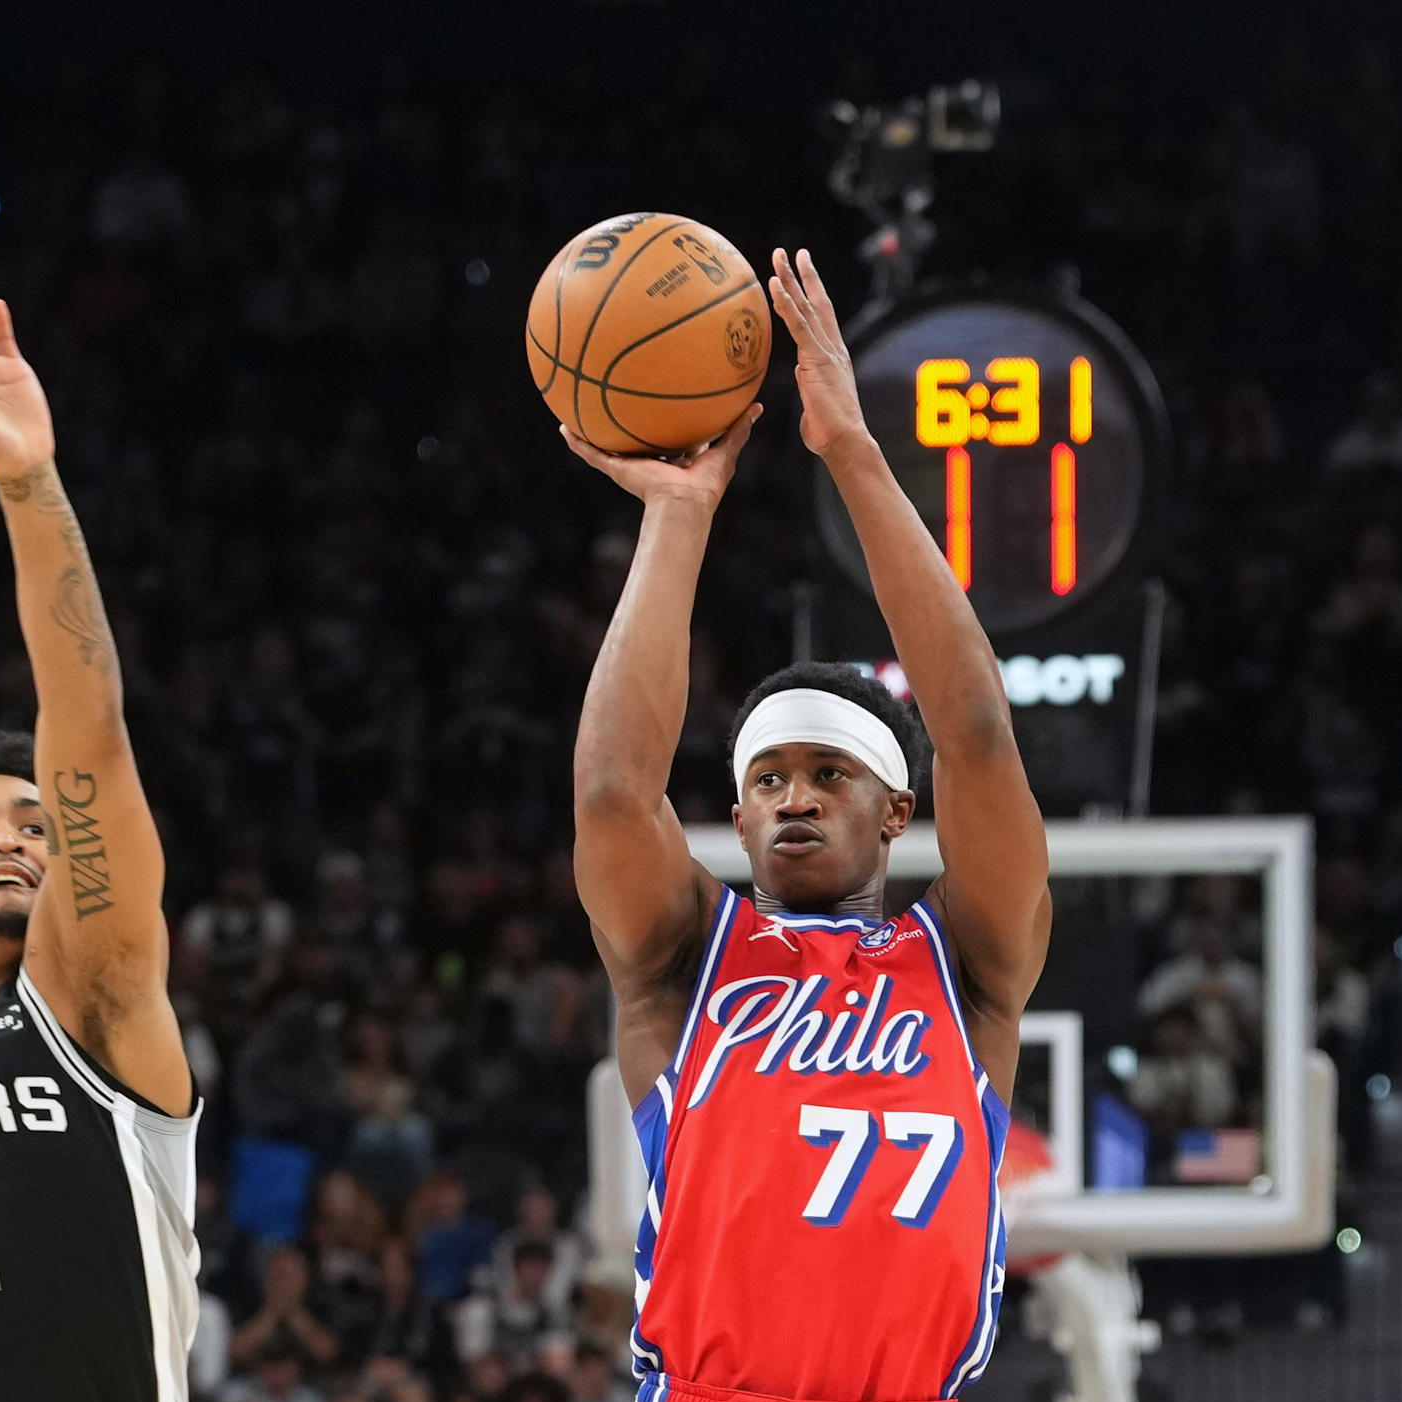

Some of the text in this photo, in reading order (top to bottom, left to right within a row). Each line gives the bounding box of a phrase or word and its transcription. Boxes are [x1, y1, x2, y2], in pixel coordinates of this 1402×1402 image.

[916, 356, 1093, 447] 6:31
[946, 442, 1076, 596] 11
[687, 974, 932, 1110] Phila
[799, 1104, 964, 1229] 77
